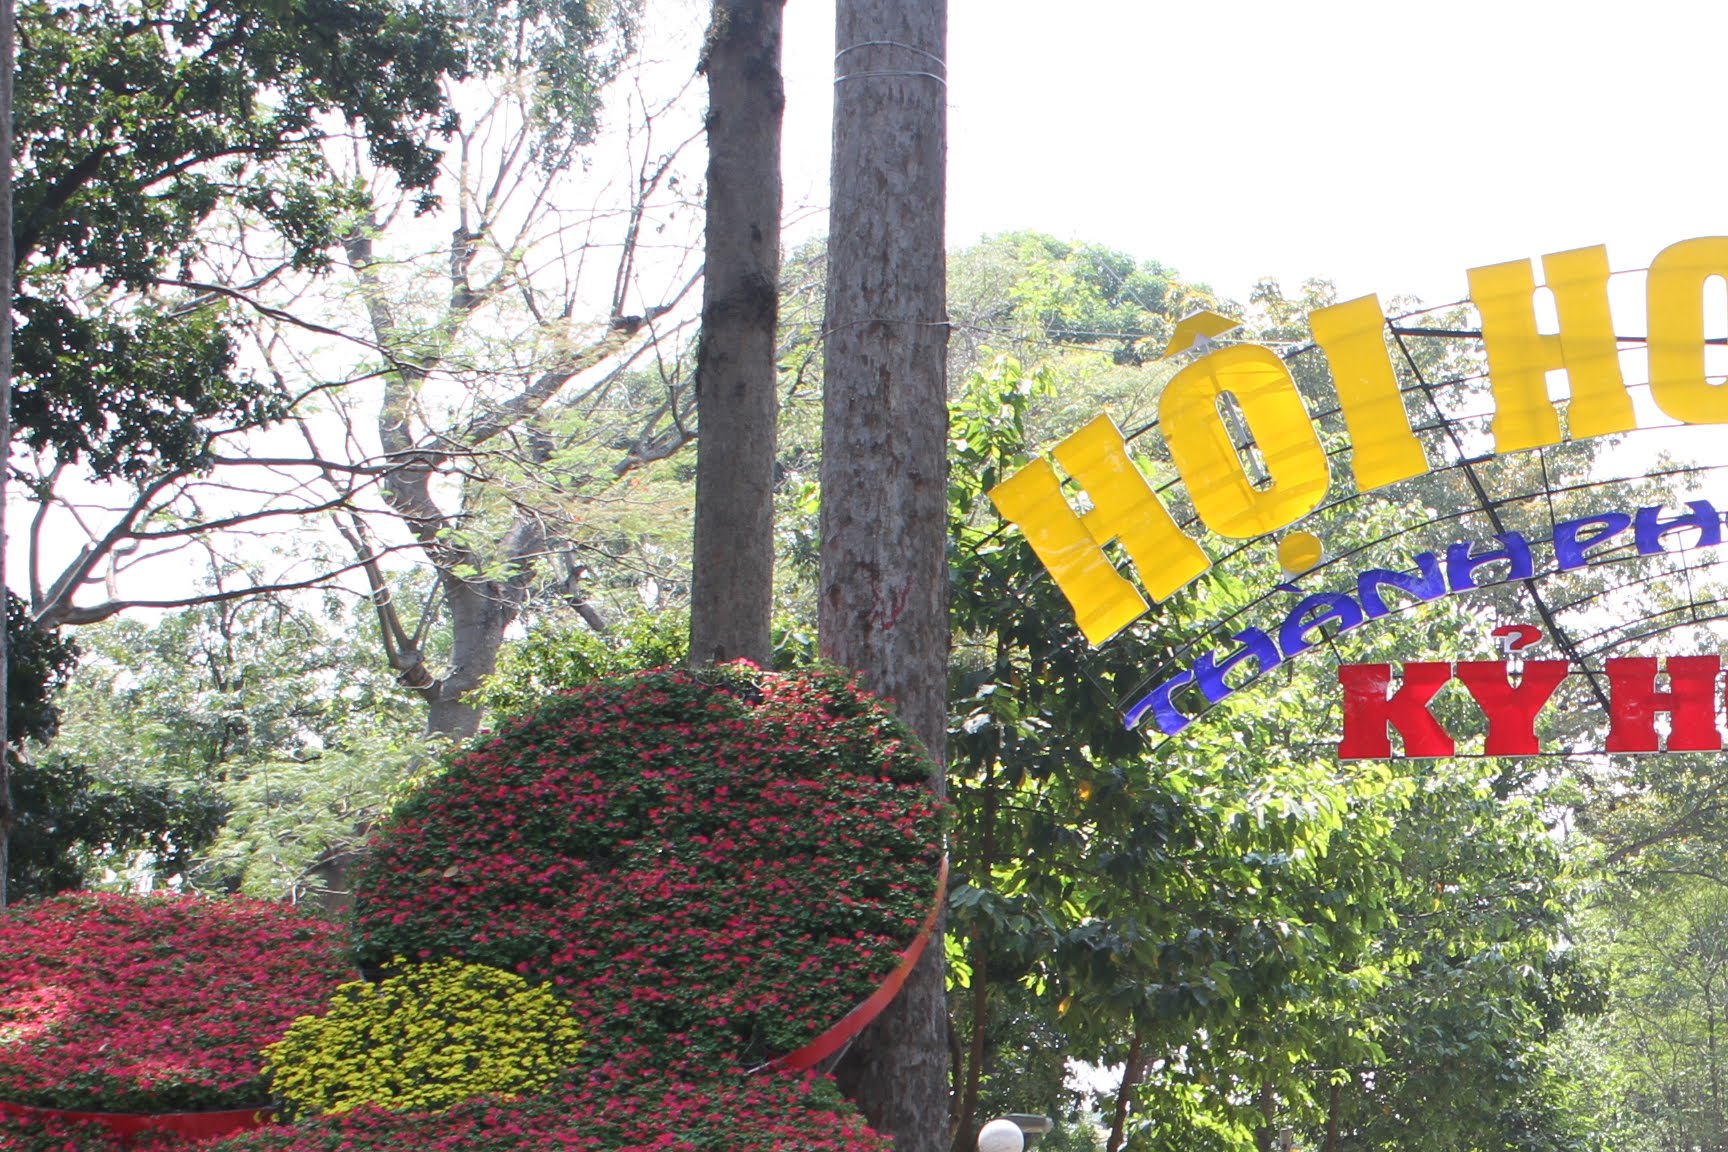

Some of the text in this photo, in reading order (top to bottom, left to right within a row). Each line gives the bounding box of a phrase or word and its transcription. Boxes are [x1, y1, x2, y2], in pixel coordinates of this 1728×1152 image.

[988, 293, 1429, 646] HỘI
[1123, 531, 1535, 737] THÀNH
[1338, 624, 1569, 760] KỶ
